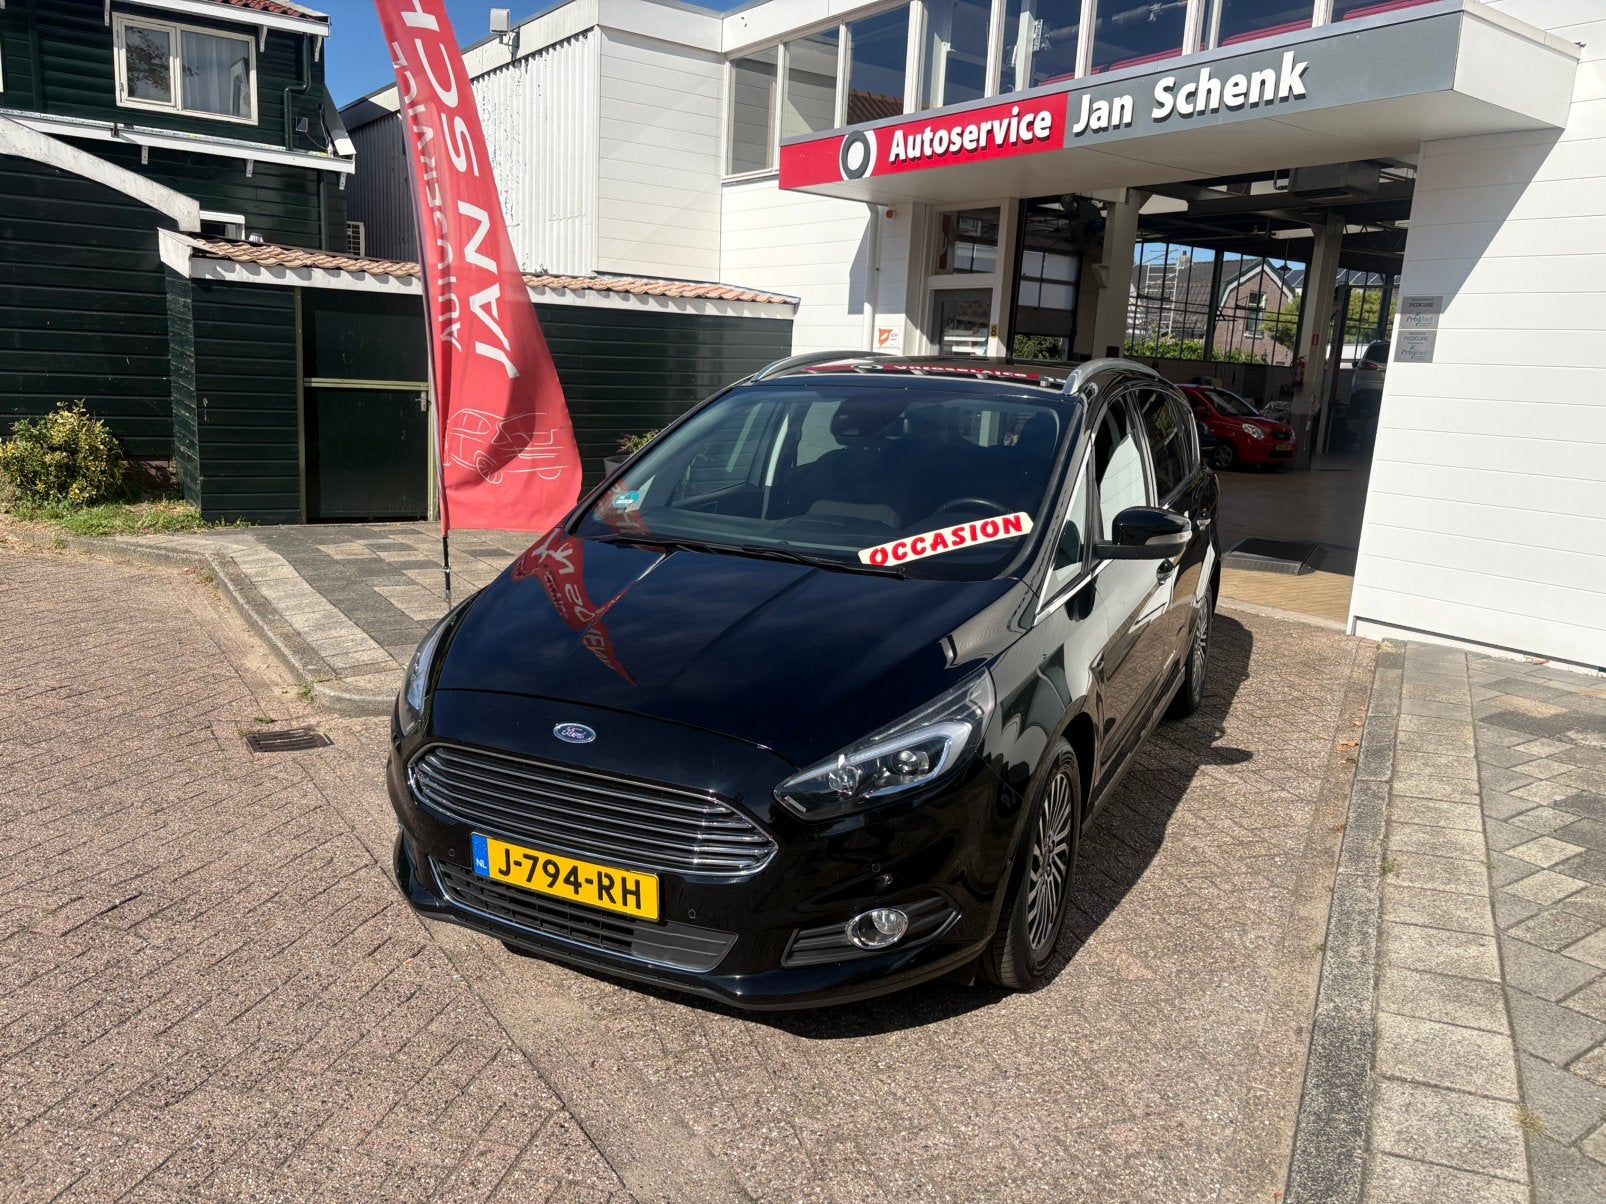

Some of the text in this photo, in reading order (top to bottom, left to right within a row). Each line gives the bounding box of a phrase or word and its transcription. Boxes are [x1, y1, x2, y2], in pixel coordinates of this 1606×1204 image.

[889, 51, 1309, 163] Autoservice Jan Schenk
[456, 199, 520, 379] JAN
[869, 515, 1023, 566] OCCASION
[561, 726, 588, 740] Ford
[475, 857, 488, 869] NL
[498, 848, 642, 910] J-794-RH
